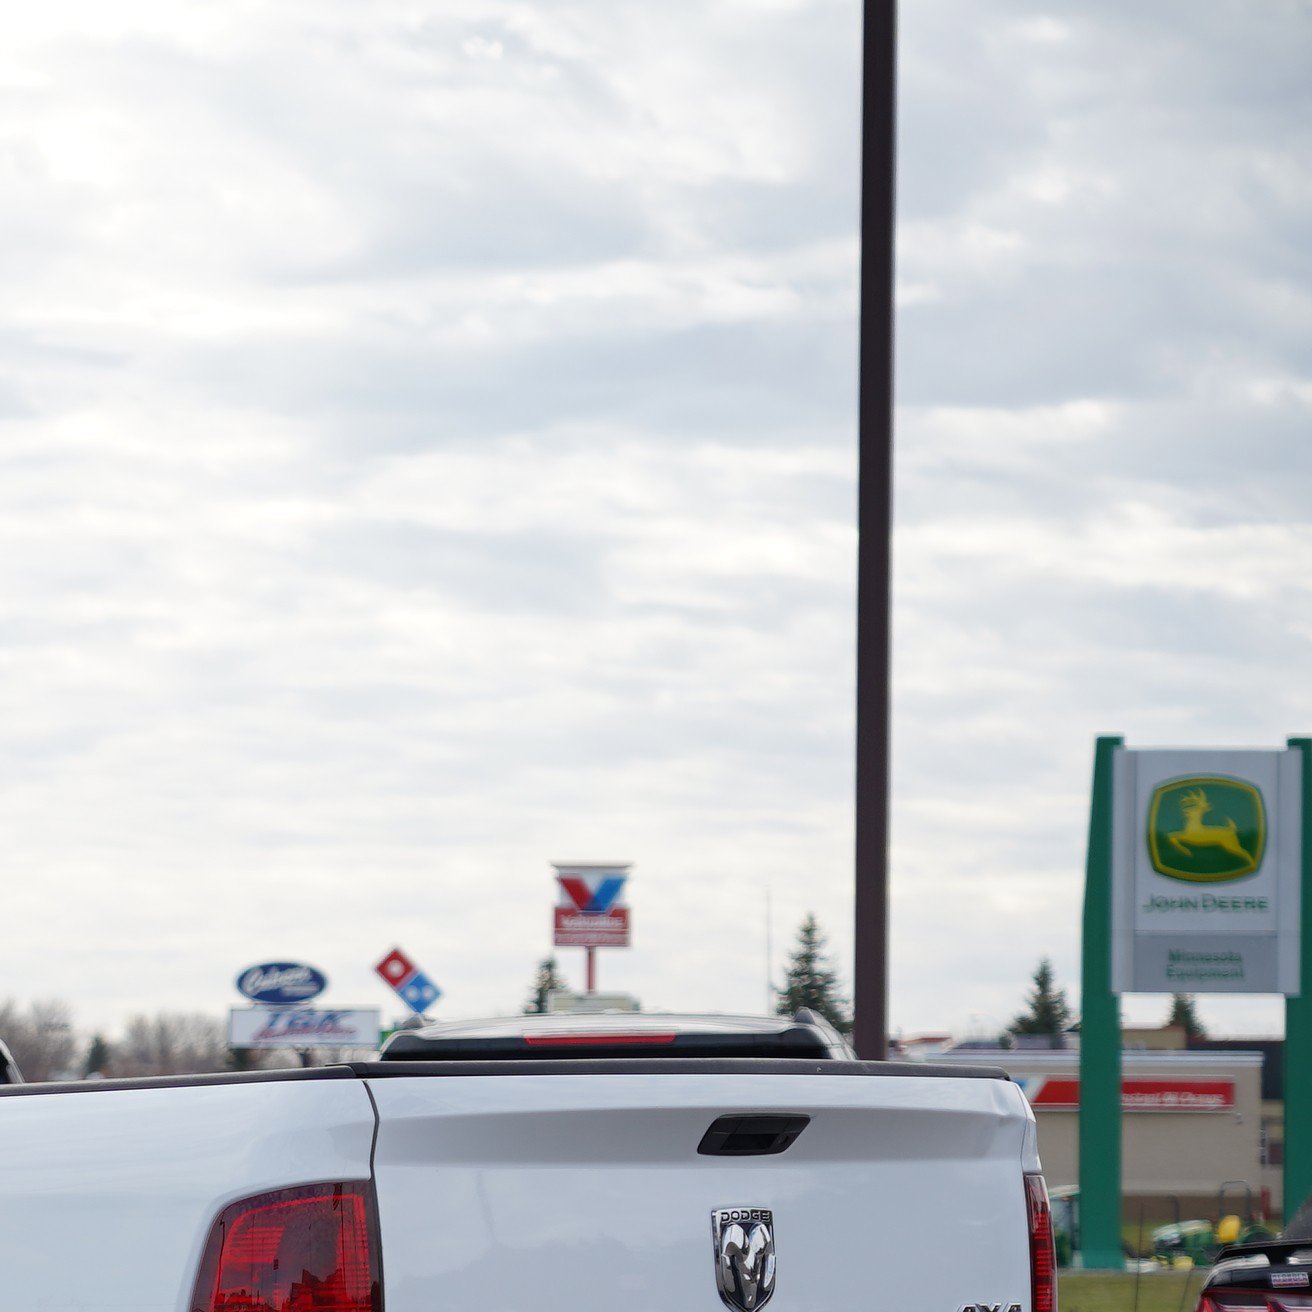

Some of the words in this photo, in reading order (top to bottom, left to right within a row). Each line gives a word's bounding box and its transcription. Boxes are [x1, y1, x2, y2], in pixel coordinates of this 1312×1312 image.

[1143, 894, 1198, 913] JOHN
[1201, 893, 1269, 912] DEERE
[720, 1210, 771, 1223] DODGE
